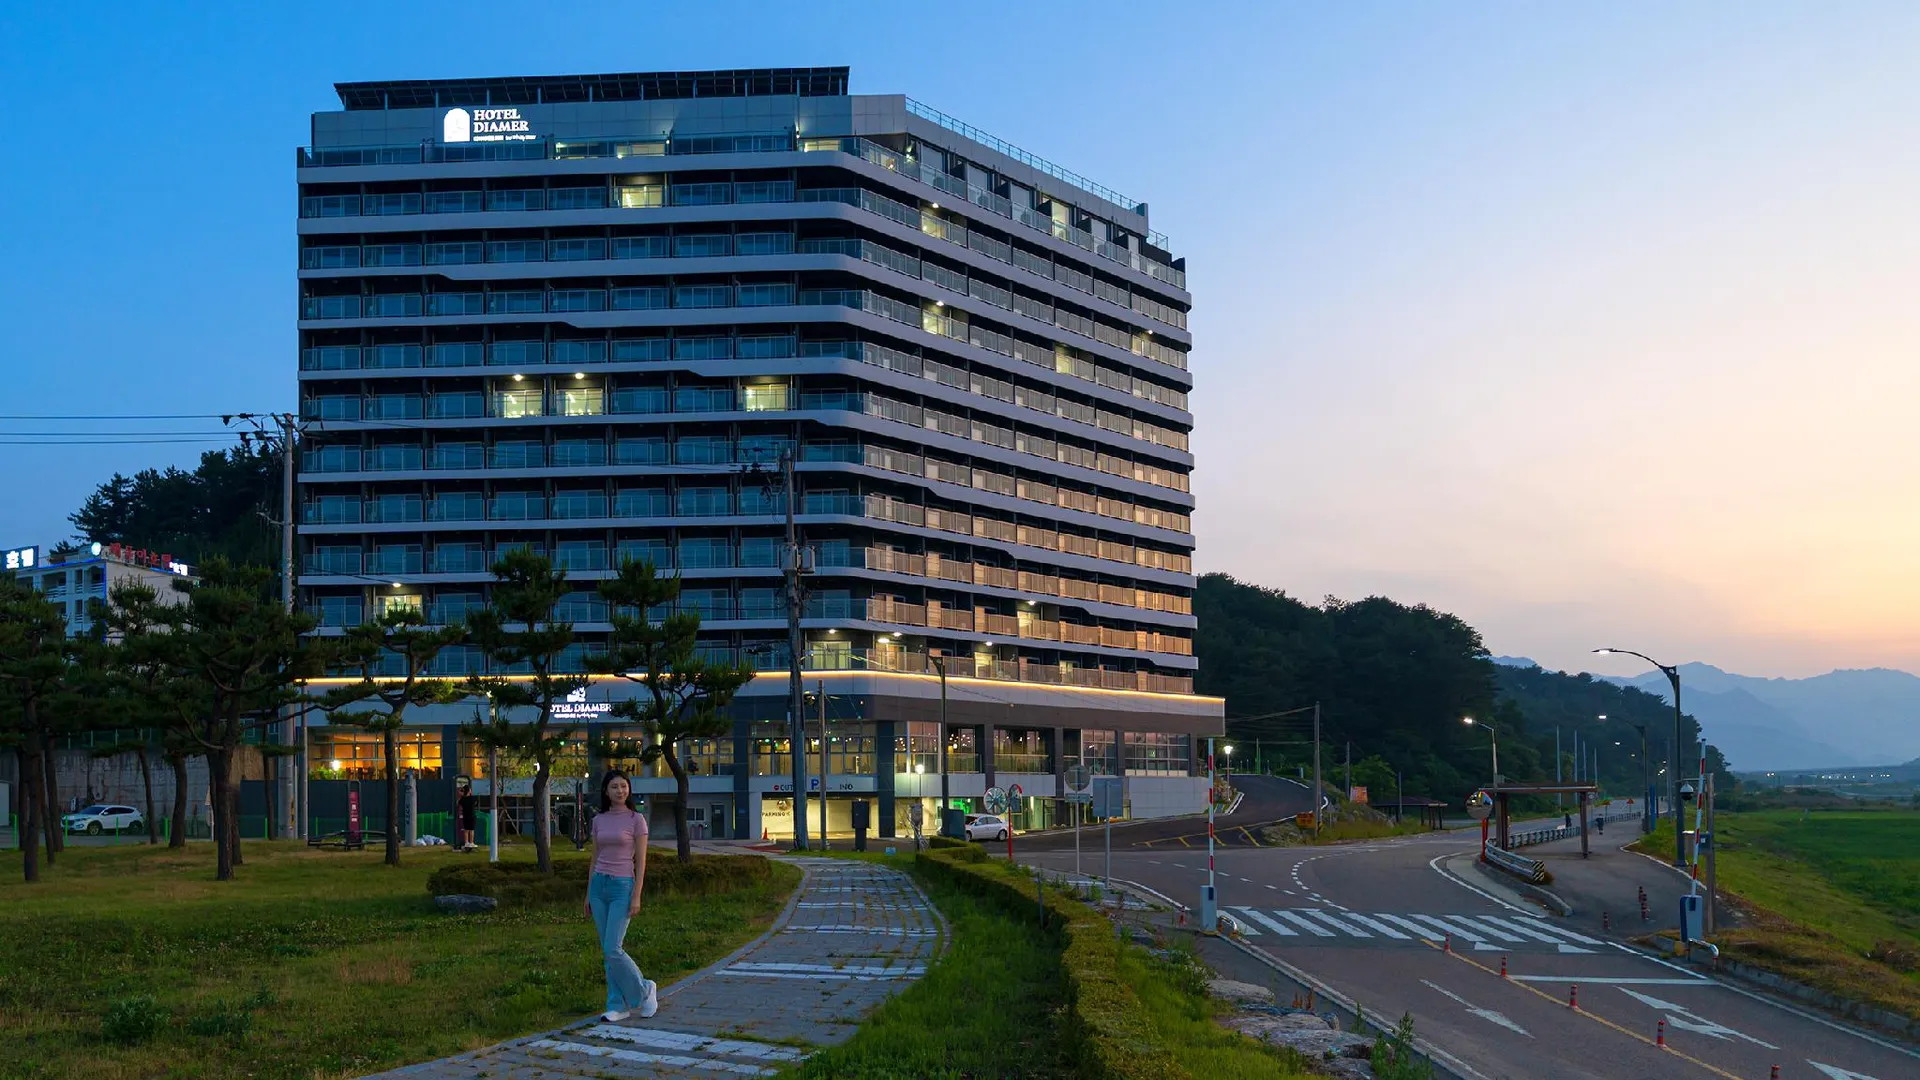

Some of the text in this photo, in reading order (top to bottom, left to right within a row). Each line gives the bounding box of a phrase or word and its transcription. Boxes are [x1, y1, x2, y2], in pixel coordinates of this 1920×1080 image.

[473, 109, 521, 120] HOTEL
[473, 121, 530, 133] DIAMER
[574, 703, 612, 713] DIAMER
[810, 778, 820, 791] P
